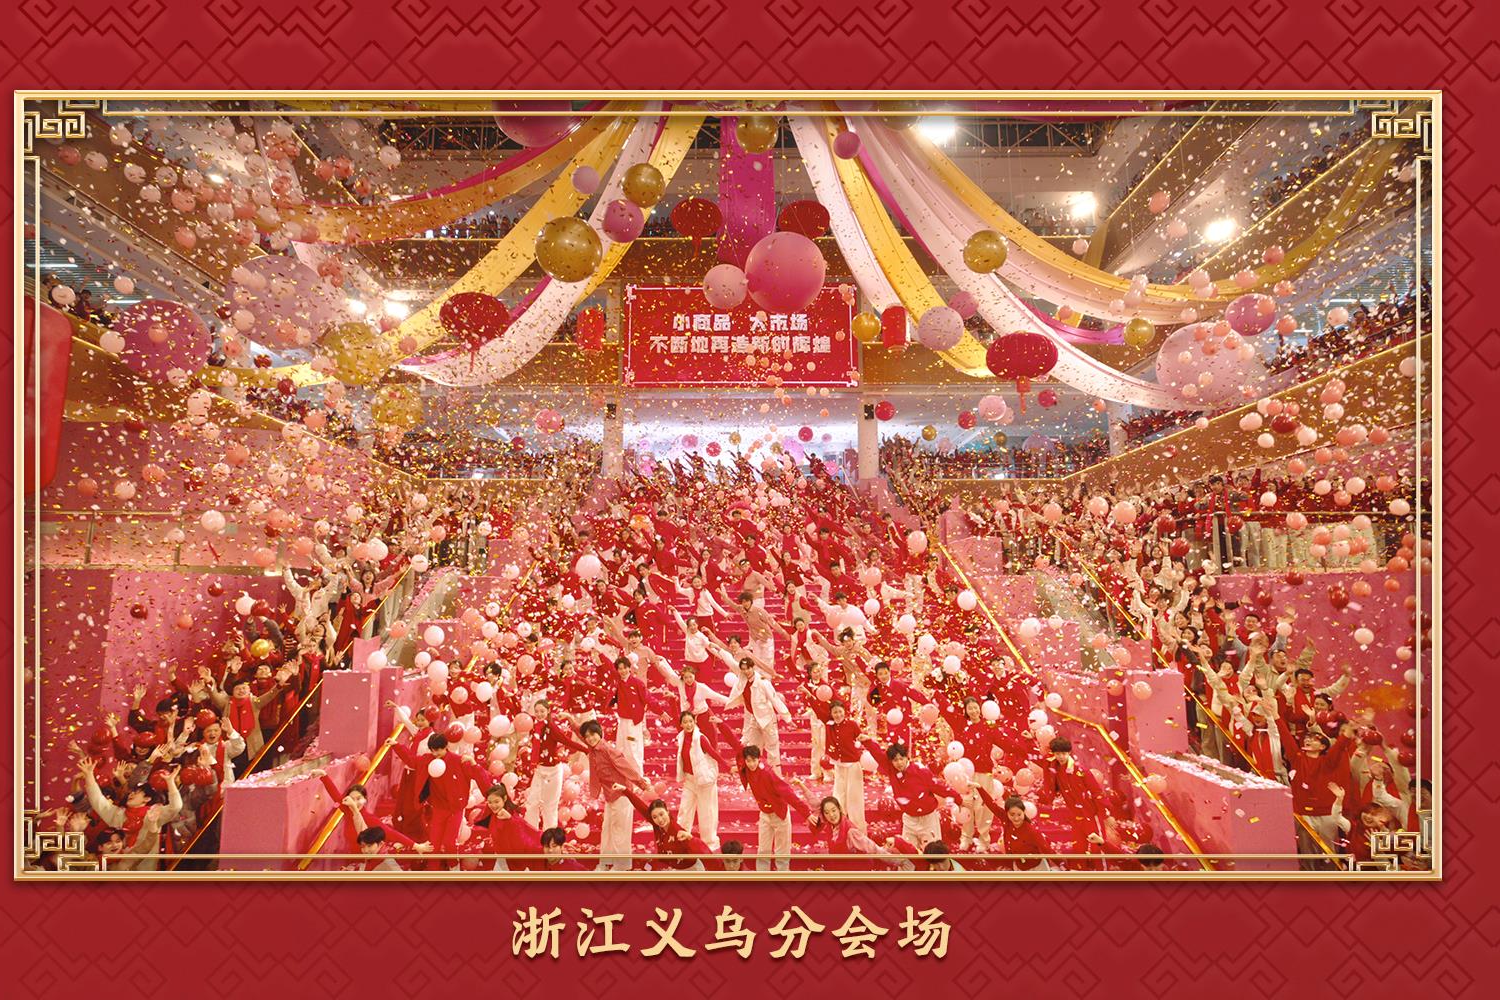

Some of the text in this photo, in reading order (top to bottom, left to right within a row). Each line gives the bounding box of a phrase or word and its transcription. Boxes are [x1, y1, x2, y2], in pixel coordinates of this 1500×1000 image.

[672, 313, 809, 331] 小商品 大市场
[649, 335, 832, 353] 不断地再造新的辉煌
